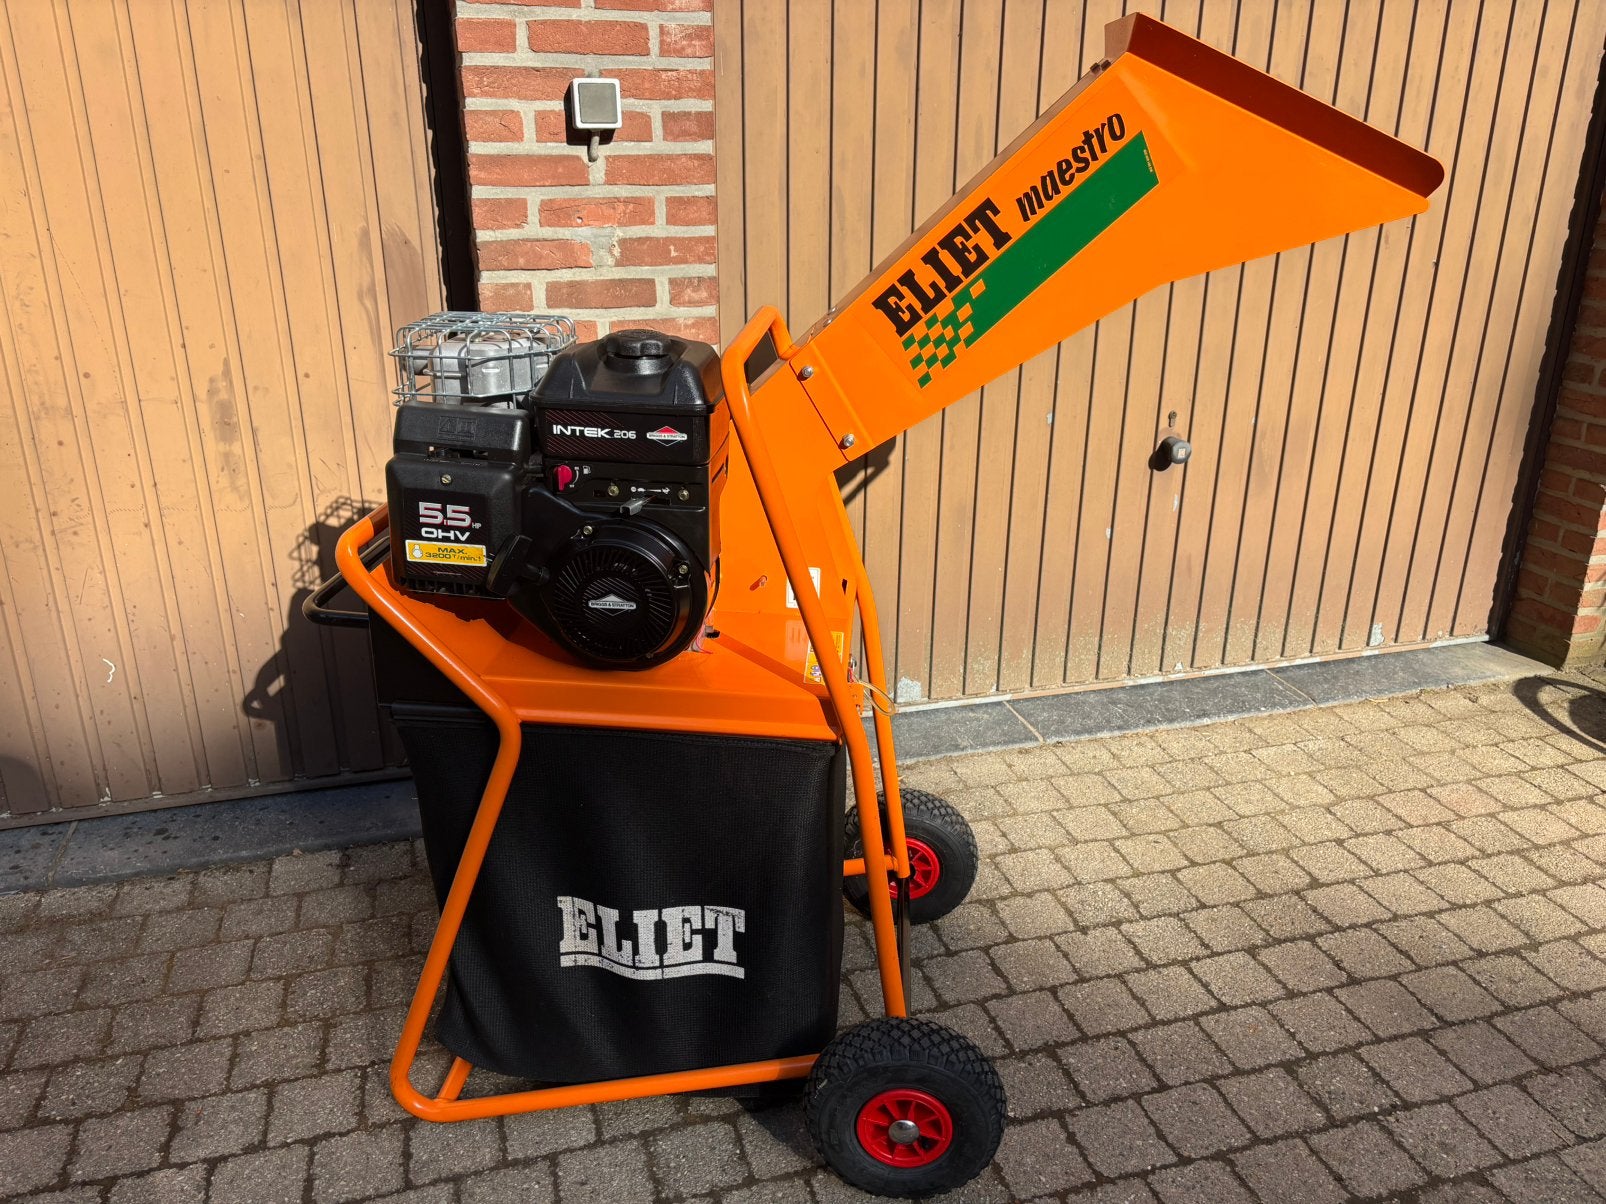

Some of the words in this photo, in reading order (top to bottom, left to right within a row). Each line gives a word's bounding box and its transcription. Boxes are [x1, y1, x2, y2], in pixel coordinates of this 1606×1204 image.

[871, 197, 1013, 339] ELIET
[1015, 112, 1126, 223] maestro
[552, 424, 612, 439] INTEK
[613, 429, 637, 440] 206
[418, 501, 472, 528] 5.5
[471, 522, 482, 530] HP
[421, 527, 471, 542] OHV
[437, 547, 468, 555] MAX.
[556, 895, 746, 969] ELIET
